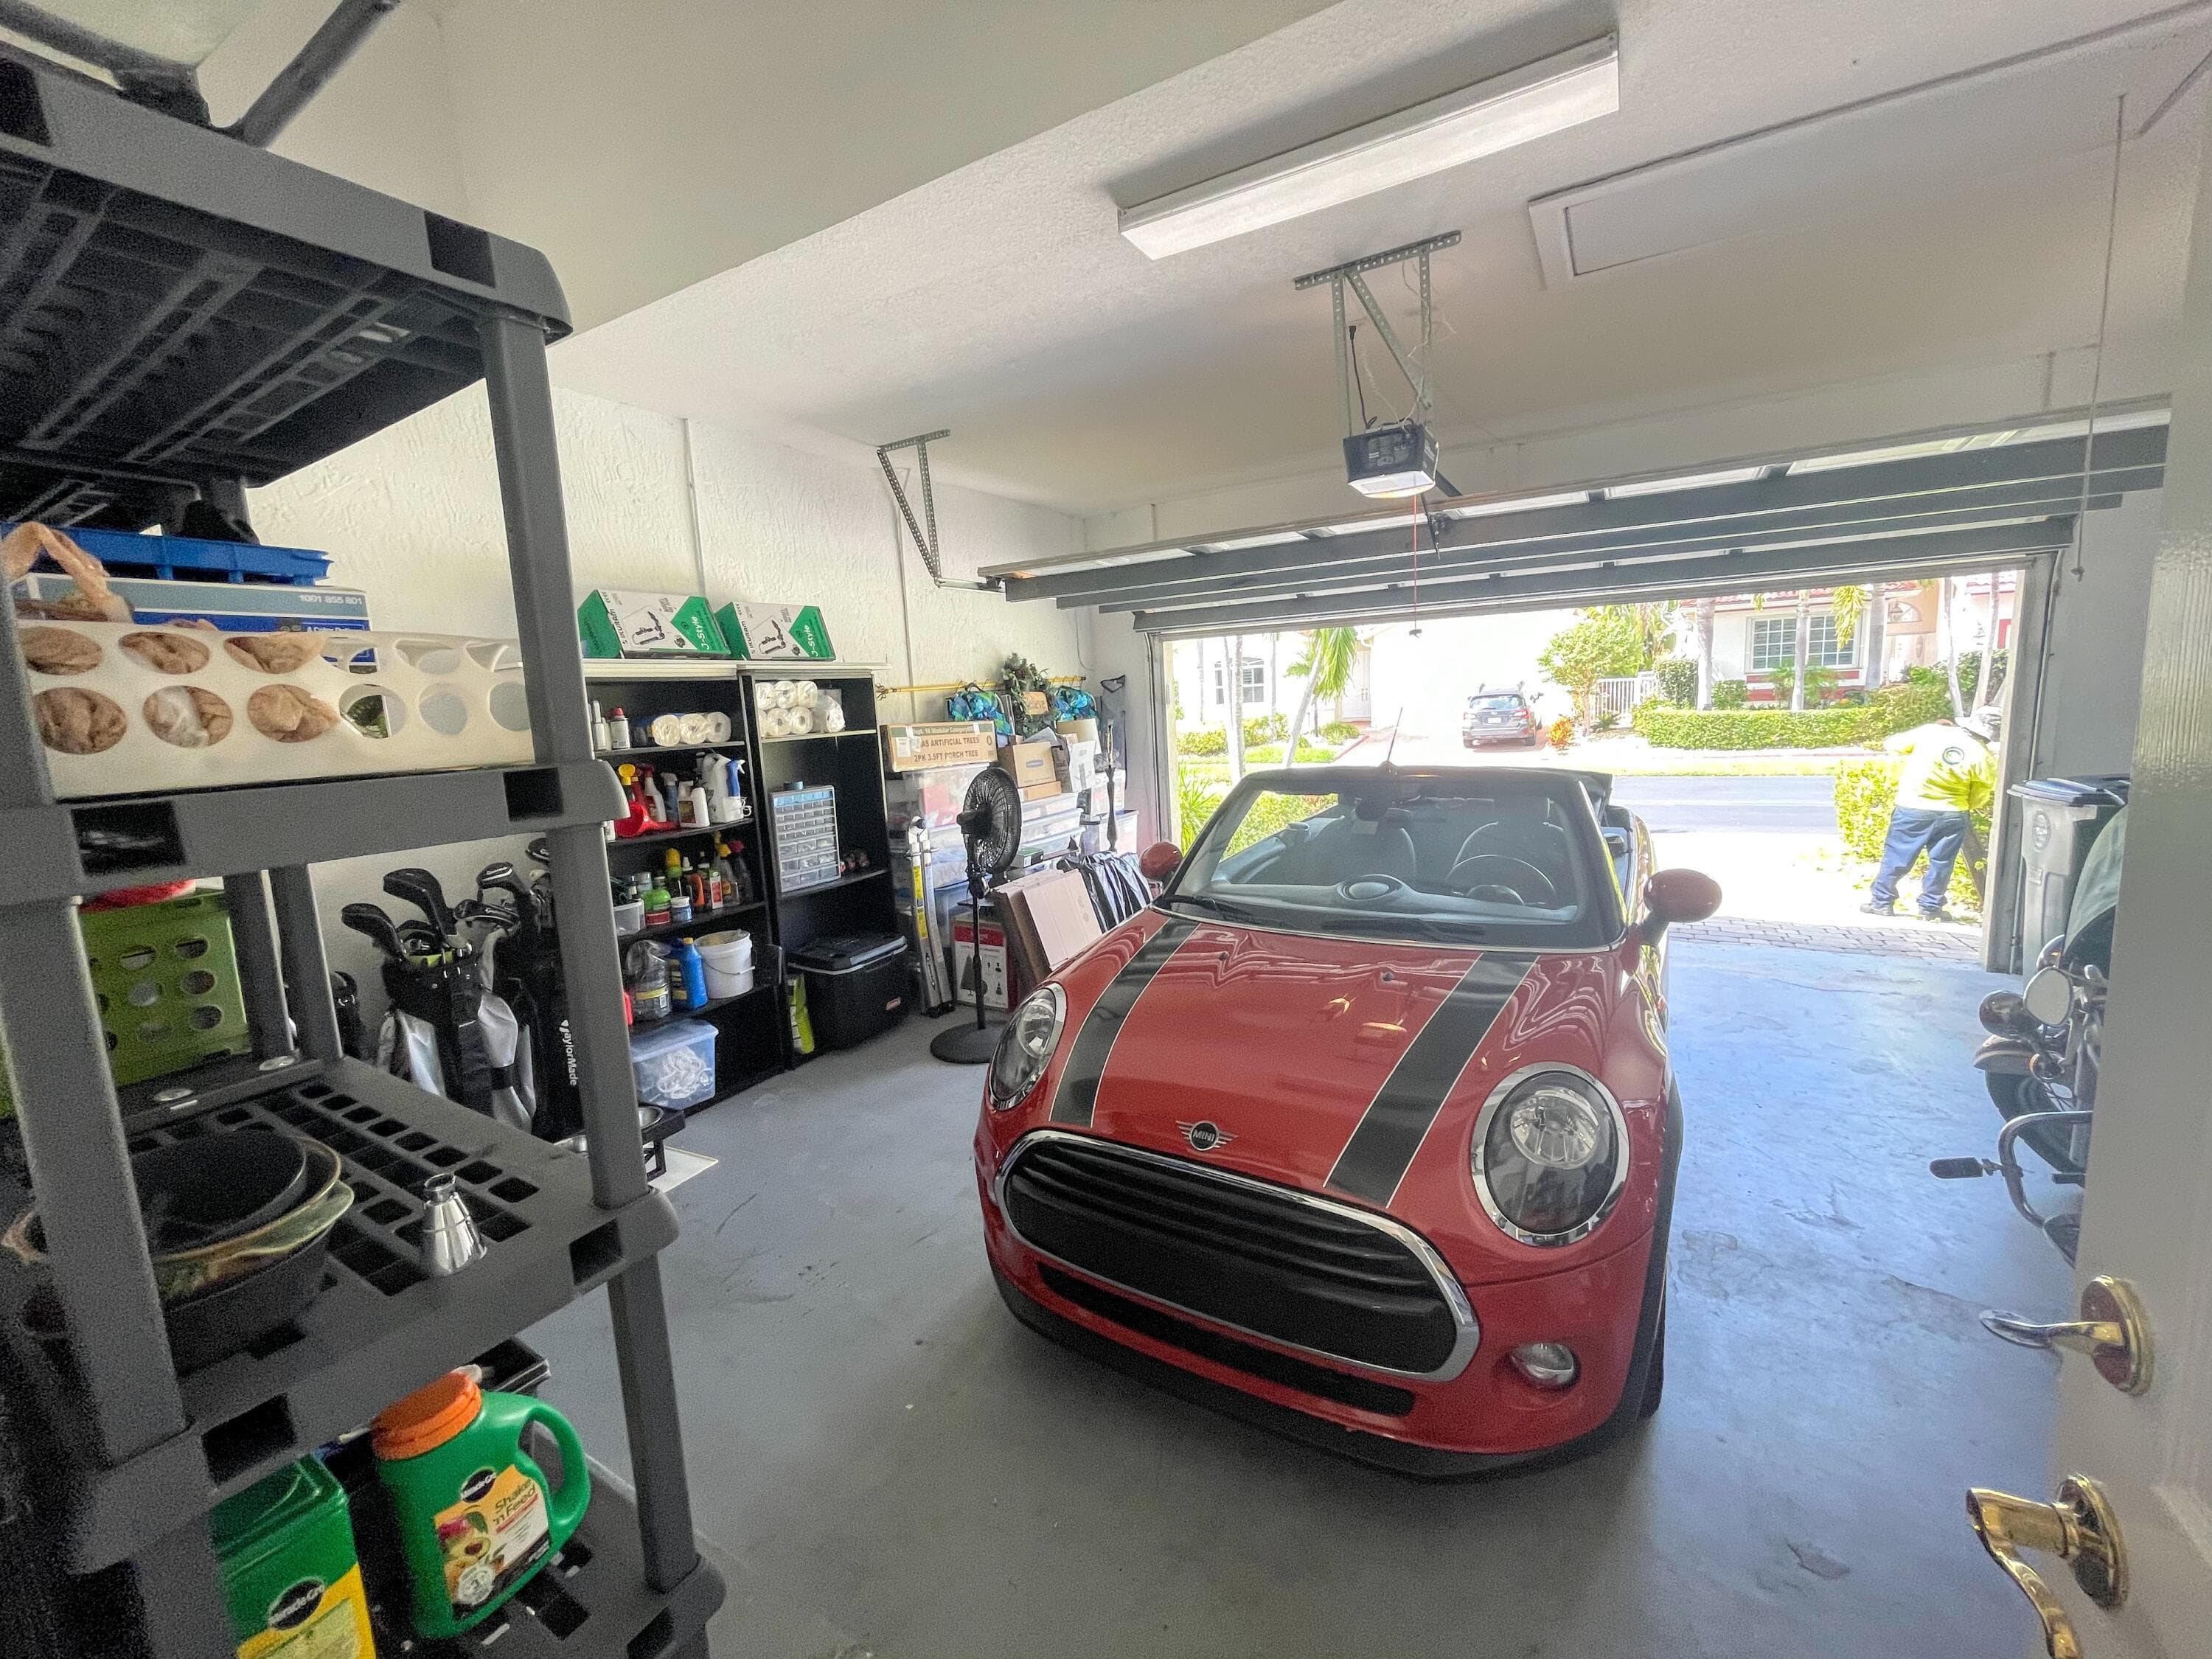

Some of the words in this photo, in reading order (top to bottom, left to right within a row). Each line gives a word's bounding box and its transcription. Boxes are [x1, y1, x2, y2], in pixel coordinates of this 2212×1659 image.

[299, 594, 322, 603] 1001
[691, 616, 710, 650] J-Style
[804, 625, 819, 657] J-Style
[914, 754, 927, 762] 2PK
[928, 753, 943, 762] 3.5FT
[945, 751, 964, 760] PORCH
[964, 749, 979, 758] TREE
[921, 739, 930, 748] AS
[931, 738, 962, 748] ARTIFICIAL
[964, 737, 980, 745] TREES
[559, 1019, 579, 1086] TaylorMade
[1192, 1129, 1215, 1142] MINI
[495, 1478, 532, 1514] Shake
[505, 1483, 536, 1517] Feed
